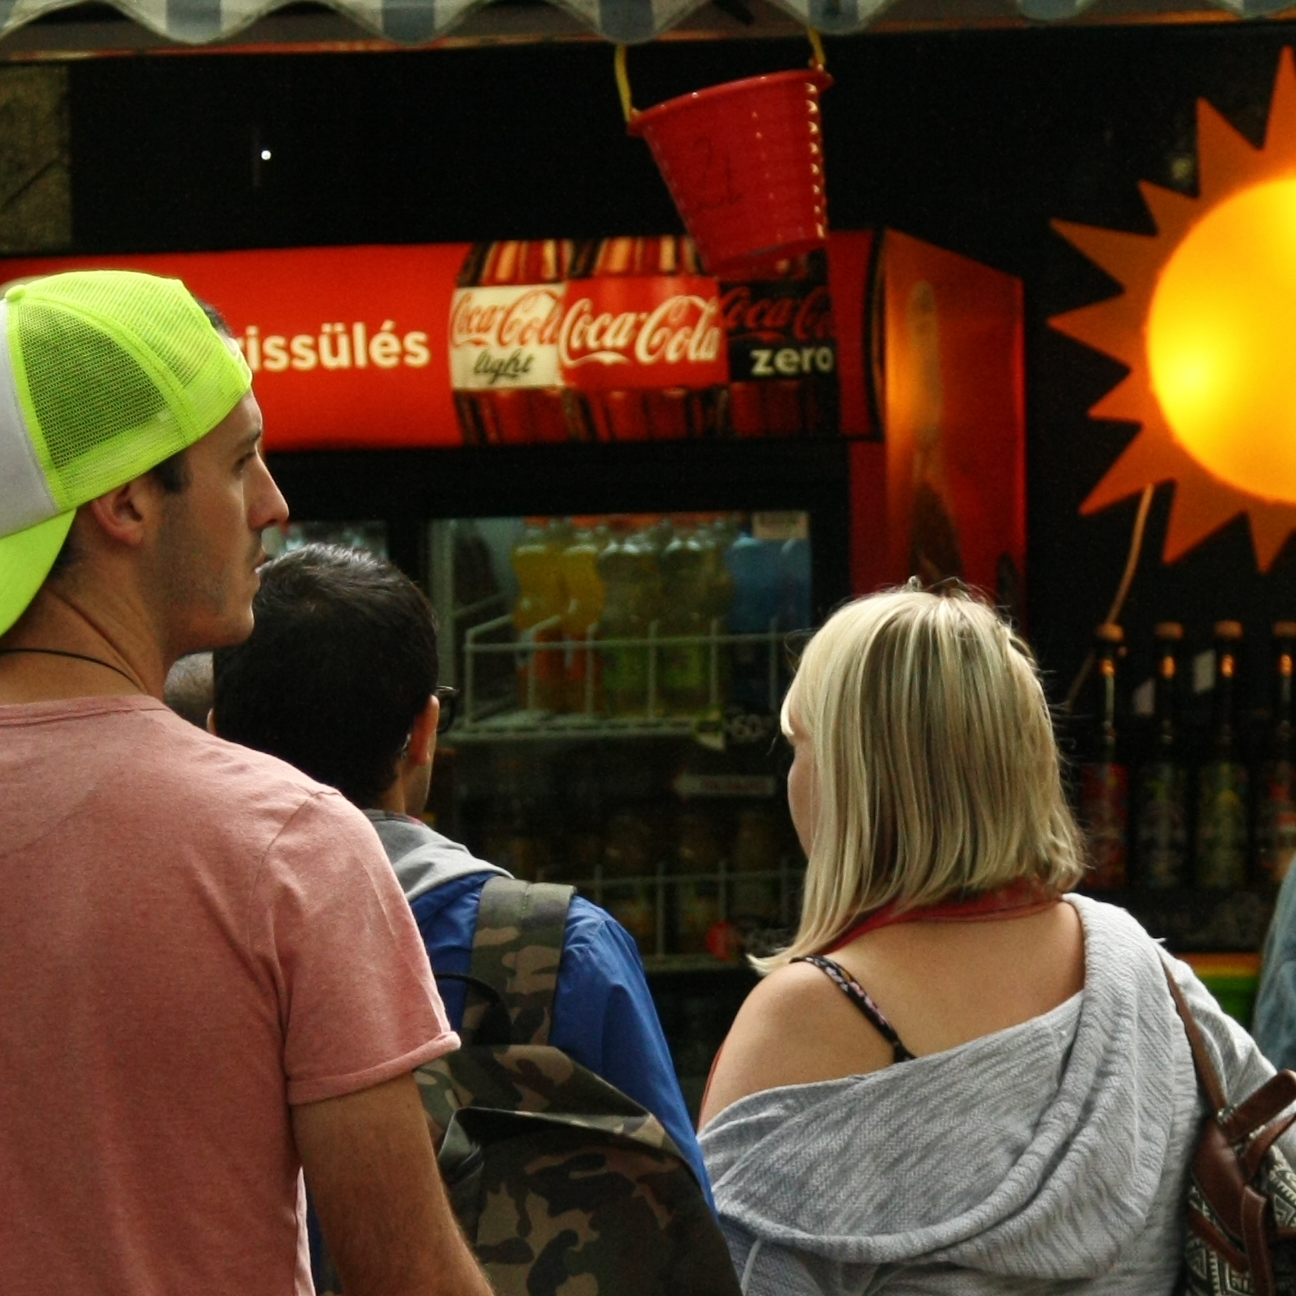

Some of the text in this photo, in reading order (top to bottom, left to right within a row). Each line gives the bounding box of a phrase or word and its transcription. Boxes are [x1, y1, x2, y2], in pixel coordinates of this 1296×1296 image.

[451, 288, 561, 384] Coca-Cola light
[558, 294, 722, 367] Coca-Cola
[749, 345, 834, 377] zero
